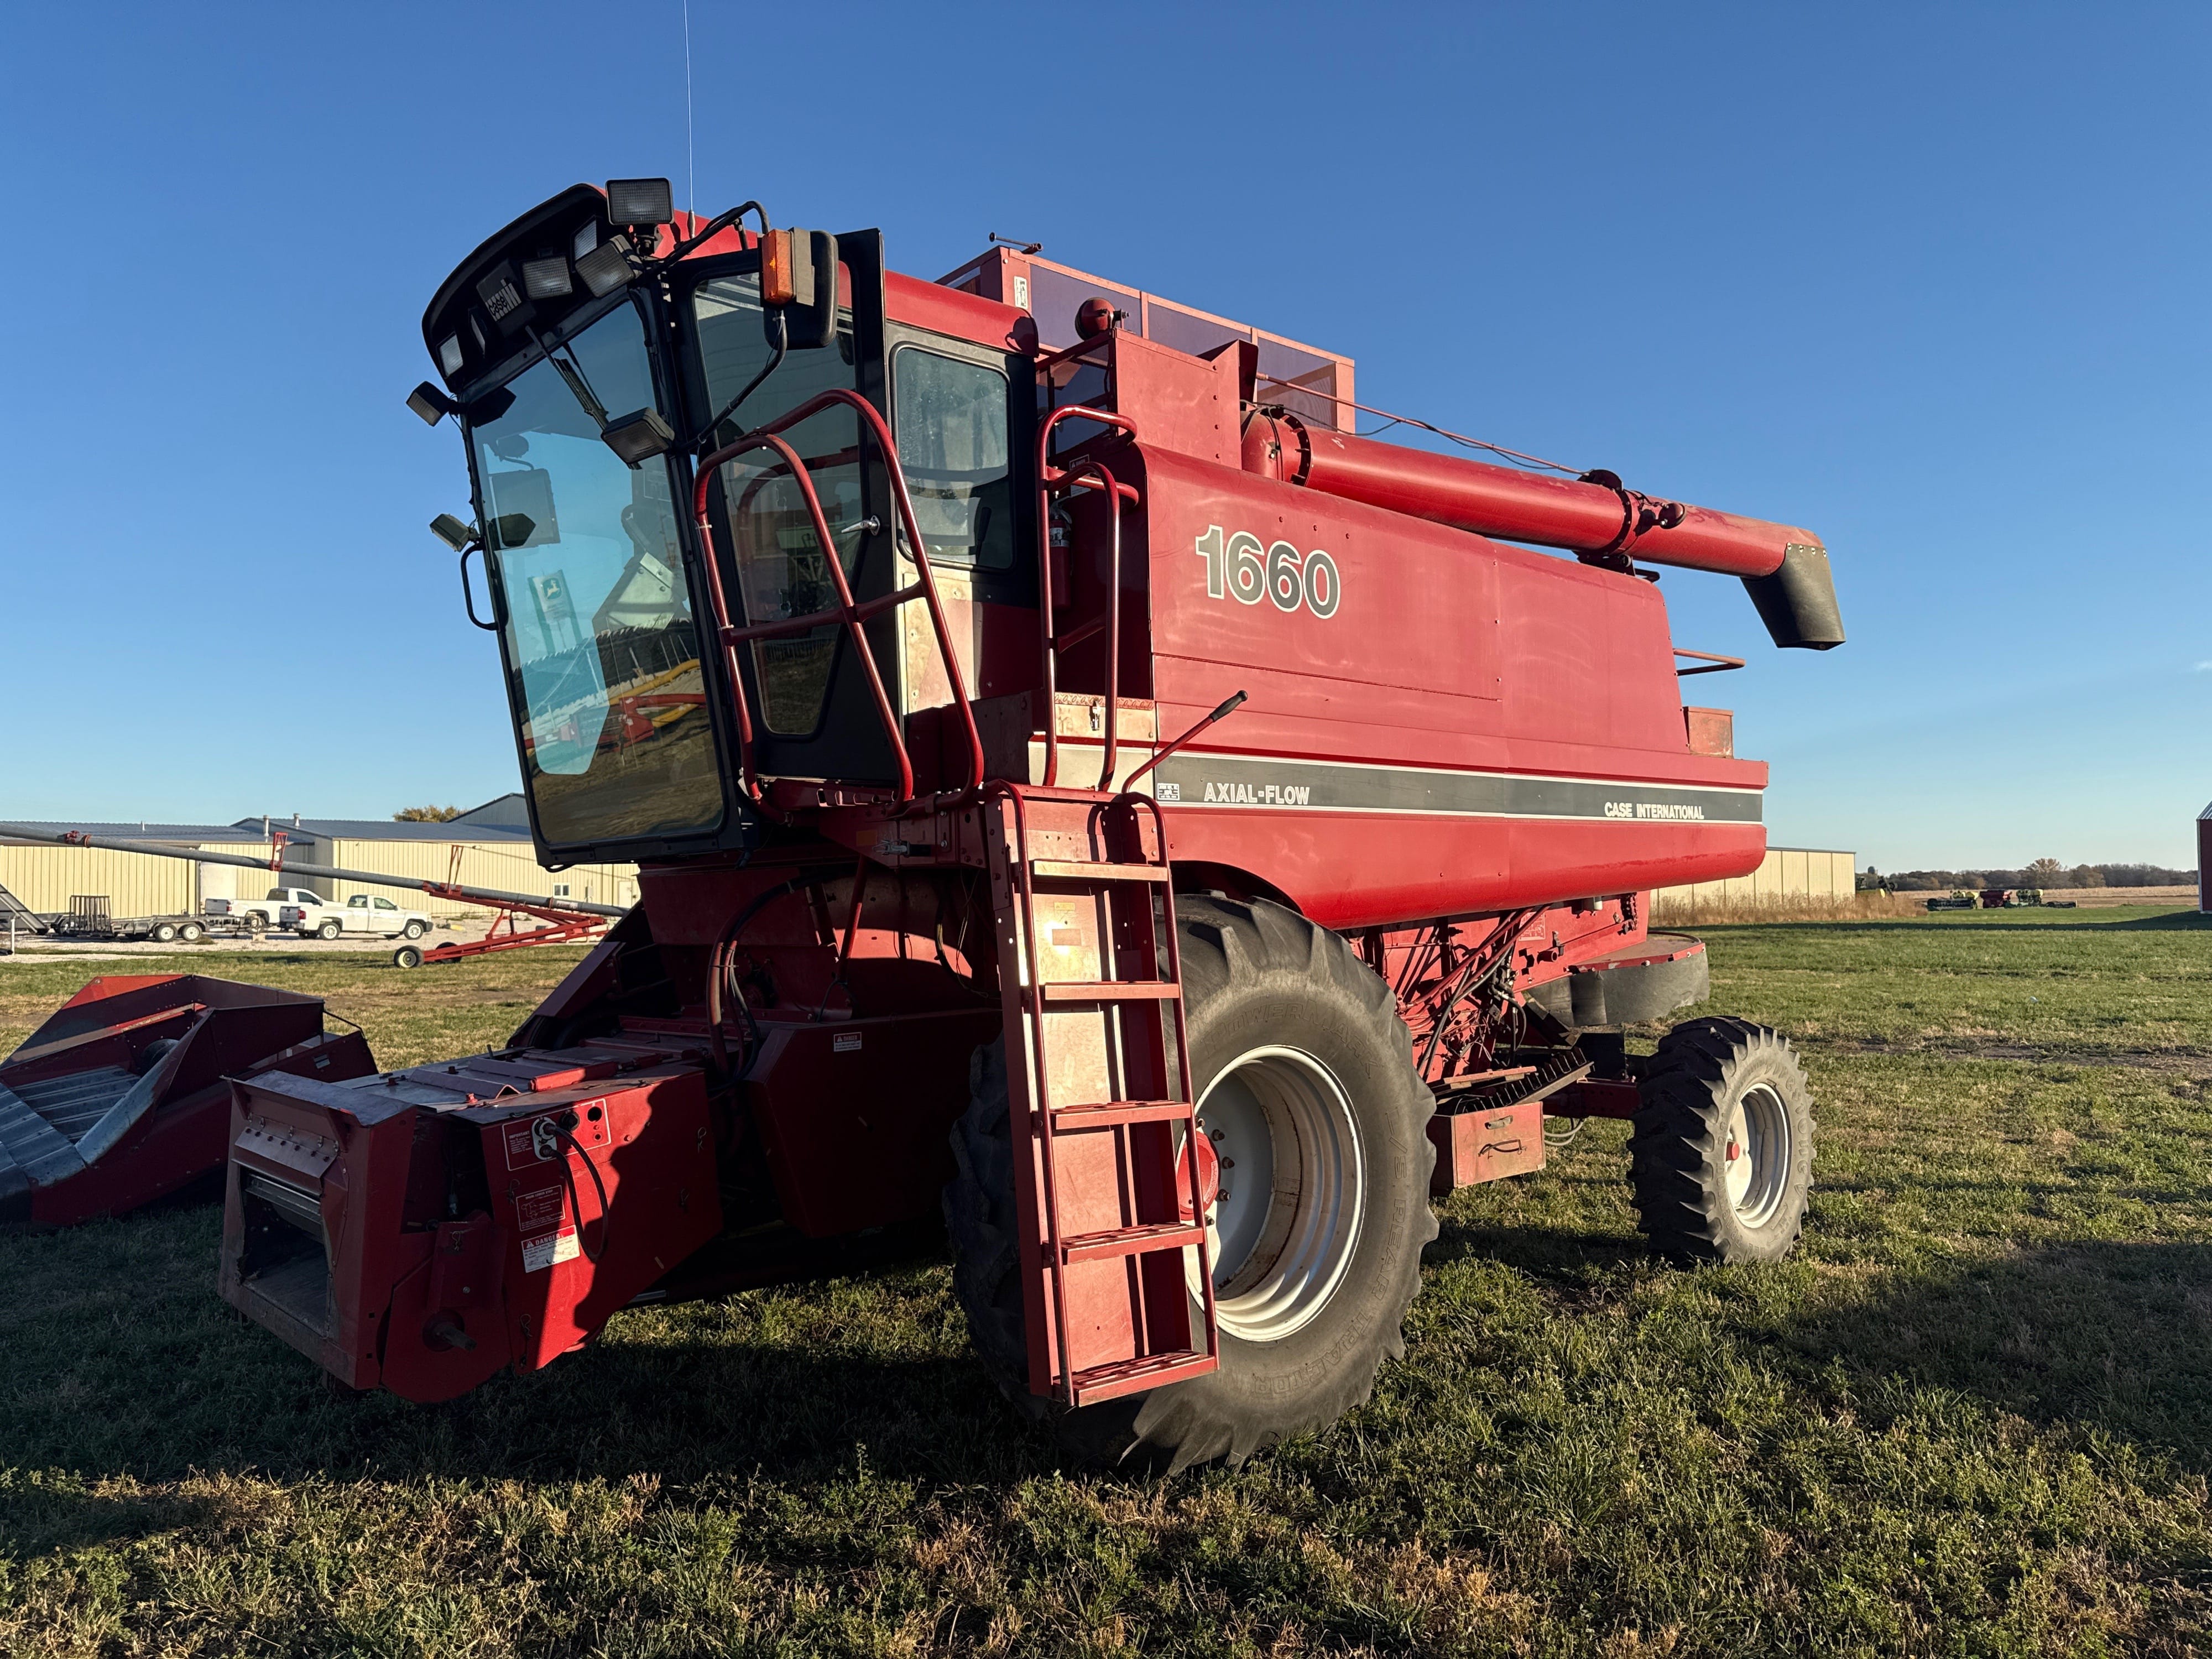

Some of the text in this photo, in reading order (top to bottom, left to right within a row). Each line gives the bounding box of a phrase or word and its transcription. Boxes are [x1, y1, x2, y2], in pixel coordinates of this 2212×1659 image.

[1196, 524, 1341, 620] 1660
[1204, 782, 1310, 805] AXIAL-FLOW
[1604, 802, 1705, 820] CASE INTERNATIONAL
[535, 1233, 561, 1246] DANGER
[1371, 1198, 1407, 1301] REAR
[1253, 1311, 1373, 1395] TRACTOR
